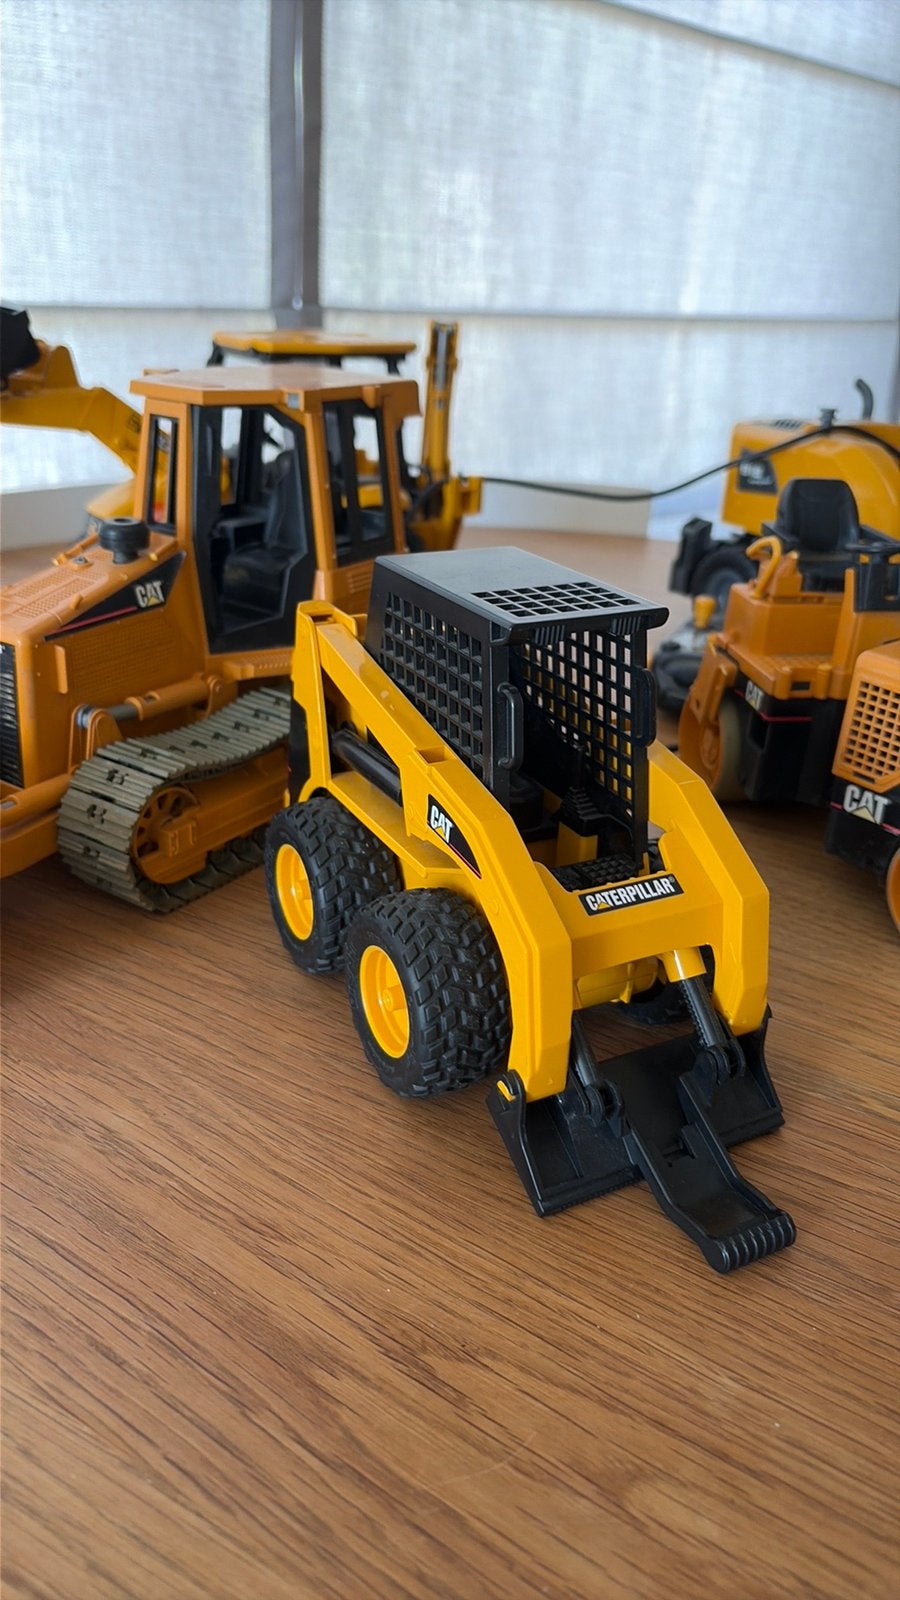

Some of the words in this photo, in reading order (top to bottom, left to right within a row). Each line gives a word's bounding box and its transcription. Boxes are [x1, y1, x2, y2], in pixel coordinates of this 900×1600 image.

[135, 580, 165, 608] CAT
[843, 784, 892, 825] CAT
[430, 805, 454, 843] CAT
[585, 877, 676, 911] CATERPILLAR
